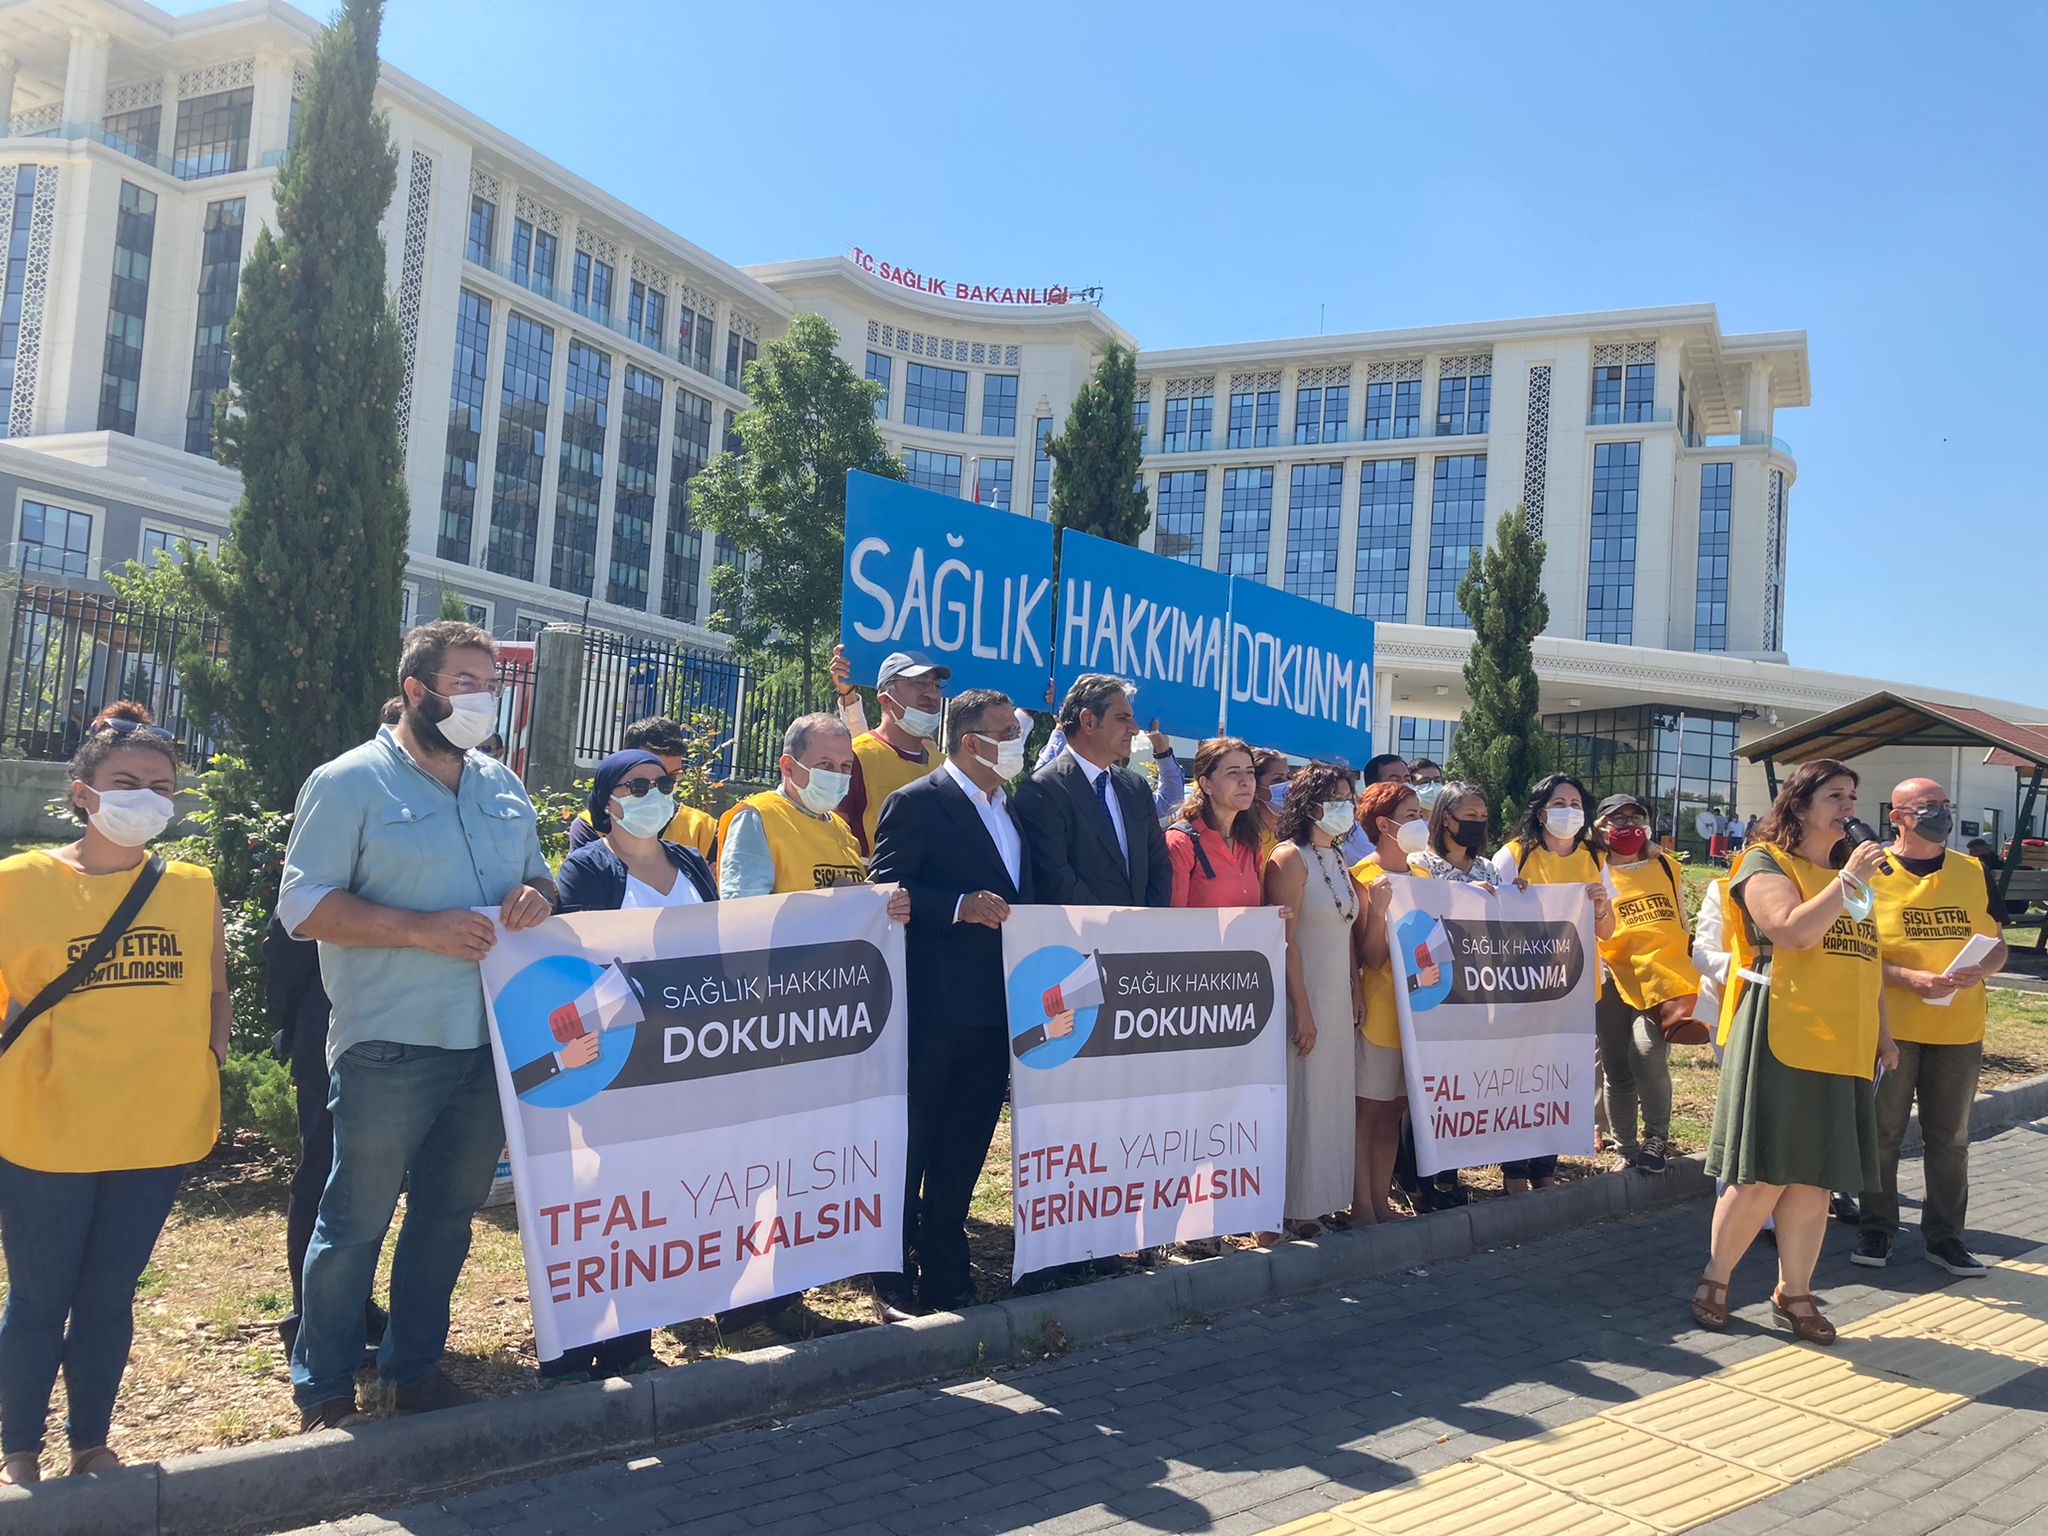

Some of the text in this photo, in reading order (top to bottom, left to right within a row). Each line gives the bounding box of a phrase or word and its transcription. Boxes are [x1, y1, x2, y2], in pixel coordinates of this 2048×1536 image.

[853, 247, 1068, 305] T.C. SAĞLIK BAKANLIĞI
[849, 532, 1373, 733] SAĞLIK HAKKIMA DOKUNMA
[1934, 910, 1971, 924] ETFAL
[122, 933, 183, 957] ETFAL
[1462, 935, 1571, 955] SAĞLIK HAKKIMA
[662, 964, 870, 1010] SAĞLIK HAKKIMA
[1118, 971, 1260, 996] SAĞLIK HAKKIMA
[1464, 964, 1568, 991] DOKUNMA
[662, 1002, 872, 1064] DOKUNMA
[1113, 1003, 1256, 1040] DOKUNMA
[1473, 1063, 1569, 1099] YAPILSIN
[1431, 1101, 1570, 1139] İNDE KALSIN
[1018, 1120, 1258, 1188] ETFAL YAPILSIN
[539, 1139, 878, 1247] TFAL YAPILSIN
[1018, 1166, 1261, 1236] YERİNDE KALSIN
[546, 1193, 882, 1304] ERİNDE KALSIN
